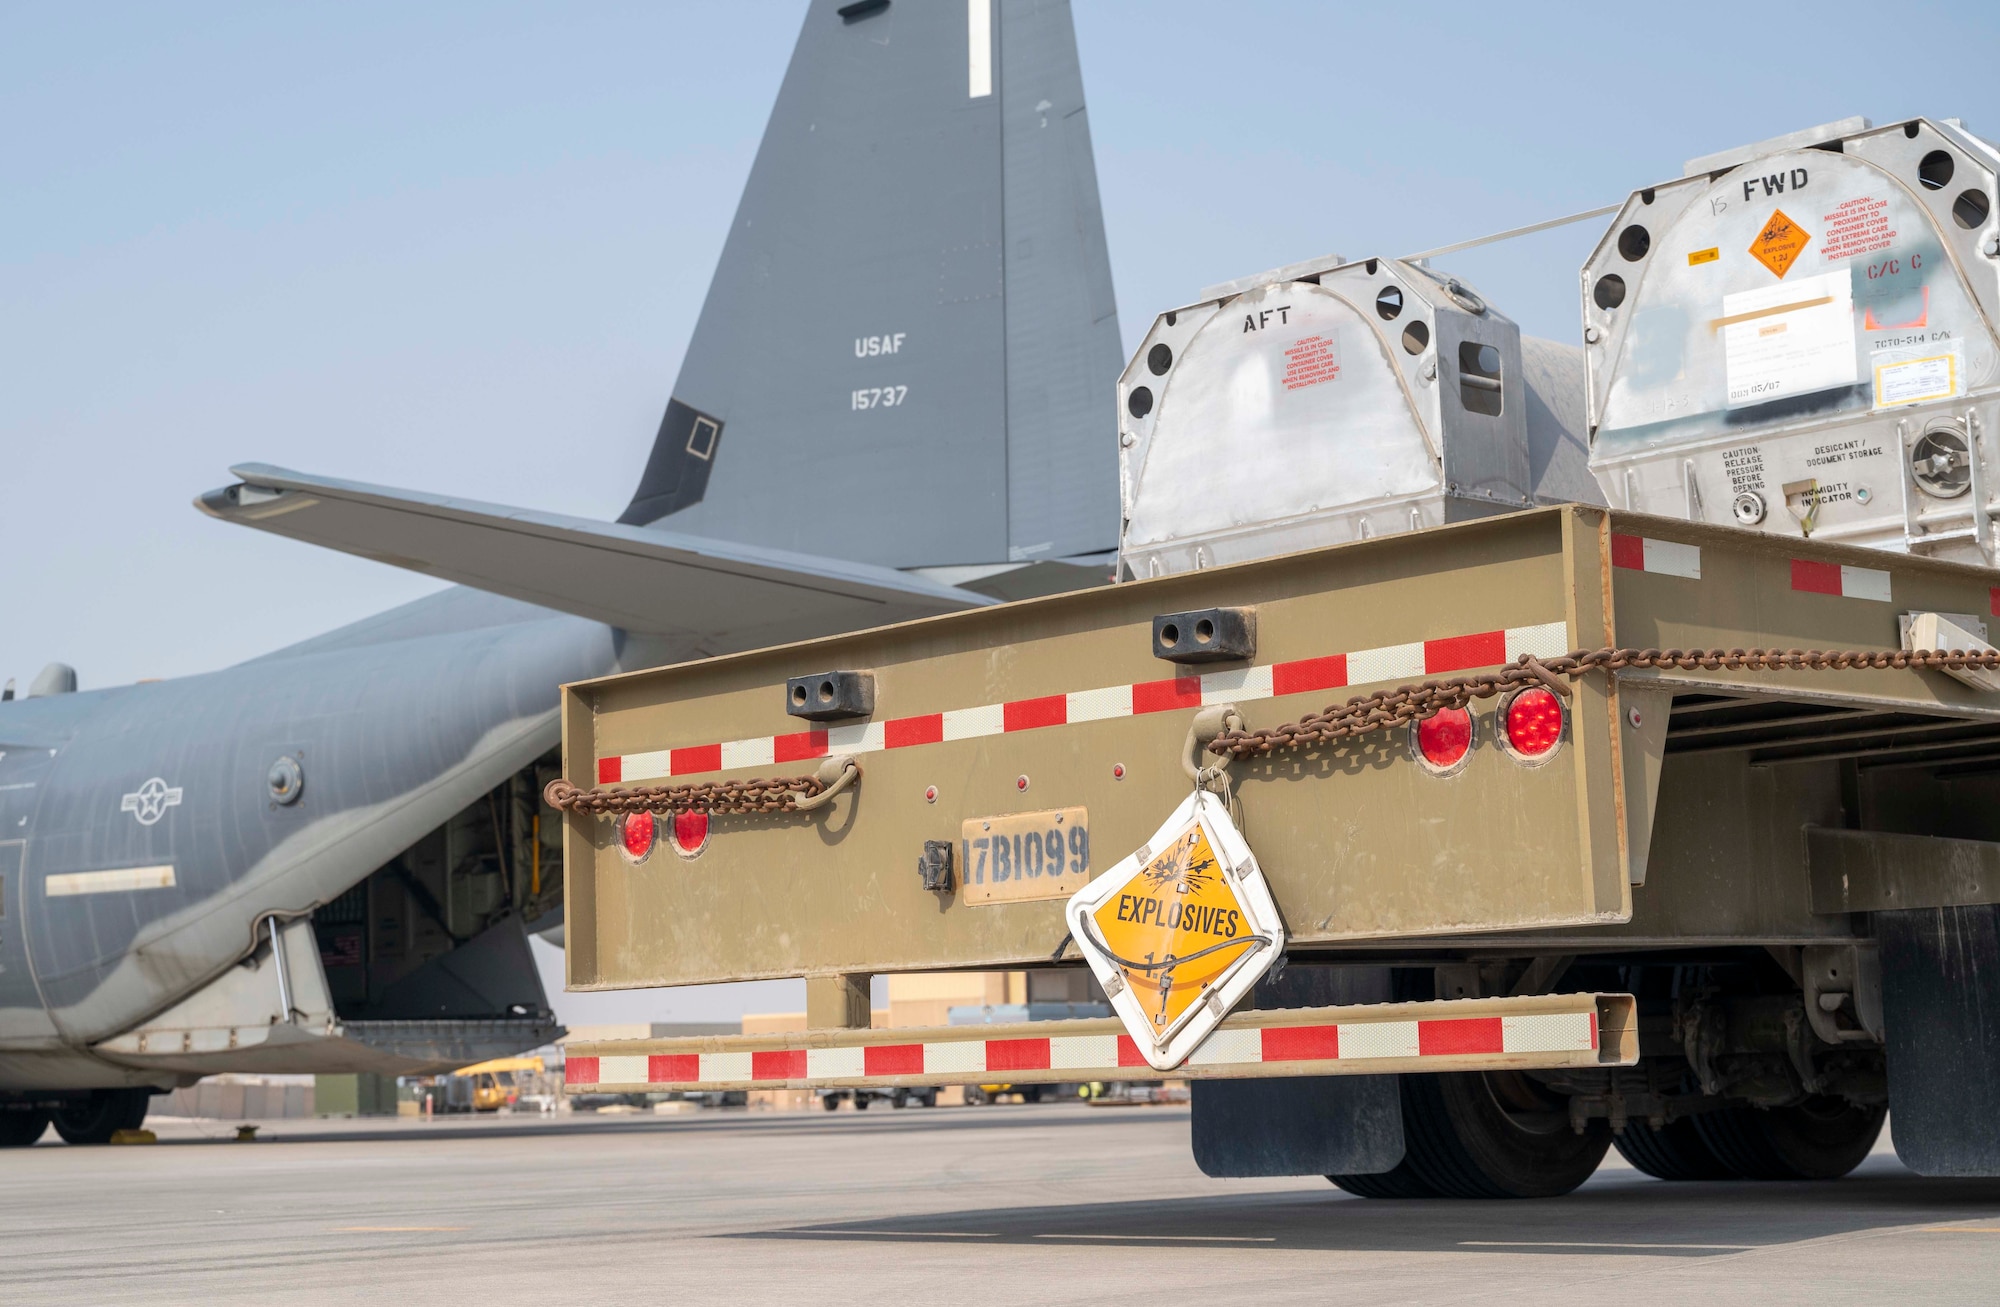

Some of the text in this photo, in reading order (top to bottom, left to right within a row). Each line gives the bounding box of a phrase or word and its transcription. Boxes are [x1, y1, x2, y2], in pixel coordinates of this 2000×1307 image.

[1743, 168, 1808, 201] FWD
[1710, 195, 1728, 216] 15
[1824, 210, 1848, 222] MISSILE
[1867, 200, 1888, 210] CLOSE
[1826, 216, 1888, 237] CONTAINER COVER
[1833, 210, 1880, 227] PROXIMITY TO
[1820, 231, 1896, 254] WHEN REMOVING AND
[1828, 225, 1888, 245] USE EXTREME CARE
[1763, 242, 1796, 254] EXPLOSIVE
[1828, 240, 1891, 260] INSTALLING COVER
[1772, 253, 1788, 262] 1.2J
[1868, 254, 1922, 279] C/C C
[1244, 306, 1291, 333] AFT
[855, 332, 906, 358] USAF
[1284, 347, 1303, 356] MISSILE
[1318, 339, 1333, 348] CLOSE
[1875, 334, 1925, 348] TCTO-514
[1287, 354, 1333, 369] CONTAINER COVER
[1292, 350, 1318, 360] PROXIMITY
[1298, 364, 1319, 373] EXTREME
[1321, 360, 1333, 368] CARE
[1299, 369, 1326, 380] REMOVING
[1288, 374, 1335, 390] INSTALLING COVER
[1752, 380, 1780, 393] 05/07
[852, 385, 908, 411] 15737
[1722, 446, 1758, 459] CAUTION
[1814, 440, 1858, 455] DESICCANT
[1724, 455, 1763, 468] RELEASE
[1806, 447, 1882, 467] DOCUMENT STORAGE
[1726, 464, 1764, 477] PRESSURE
[1732, 473, 1762, 484] BEFORE
[1733, 482, 1765, 493] OPENING
[1801, 492, 1852, 507] INICATOR
[1117, 894, 1239, 938] EXPLOSIVES
